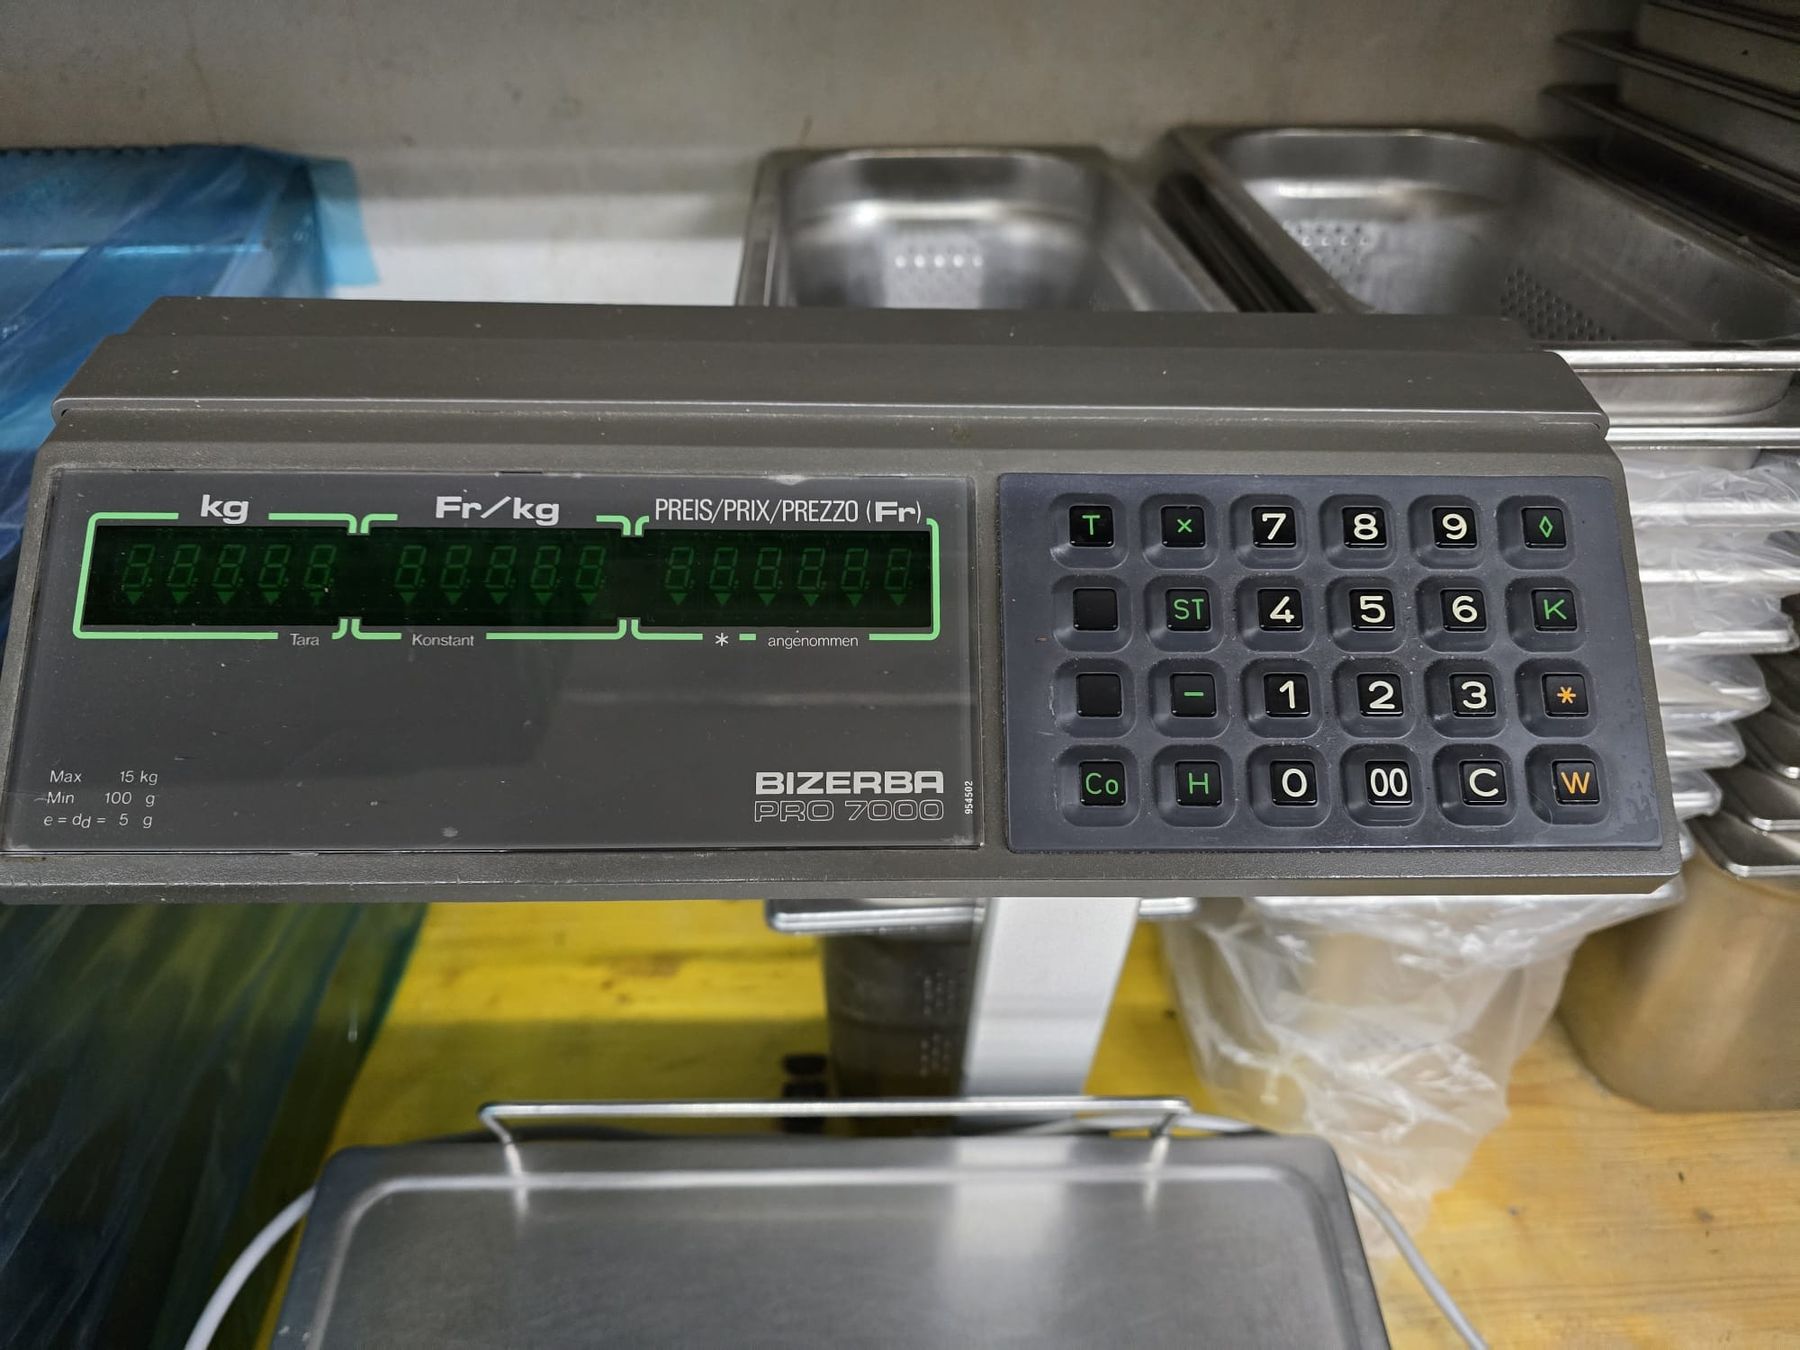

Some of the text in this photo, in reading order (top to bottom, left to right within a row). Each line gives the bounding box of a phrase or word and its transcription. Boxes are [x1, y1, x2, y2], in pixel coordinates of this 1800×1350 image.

[200, 494, 249, 525] kg
[435, 495, 560, 527] Fr/kg
[1081, 514, 1101, 536] T
[1261, 512, 1287, 541] 7
[1353, 513, 1379, 541] 8
[1442, 513, 1468, 540] 9
[1173, 598, 1205, 620] ST
[1269, 595, 1295, 624] 4
[1359, 595, 1386, 624] 5
[1452, 595, 1478, 623] 6
[1543, 599, 1567, 620] K
[289, 633, 320, 646] Tara
[411, 633, 475, 647] Konstant
[767, 634, 859, 650] angenommen
[1279, 680, 1296, 709] 1
[1368, 680, 1396, 710] 2
[1461, 680, 1487, 709] 3
[49, 769, 158, 786] Max 15 kg
[755, 770, 944, 795] BIZERBA
[1085, 772, 1119, 795] Co
[1188, 772, 1209, 795] H
[1469, 768, 1499, 797] C
[1560, 771, 1590, 794] W
[46, 791, 156, 808] Min 100 g
[964, 780, 974, 815] 954502
[118, 813, 129, 826] 5
[142, 815, 153, 829] g
[754, 799, 945, 823] PRO 7000
